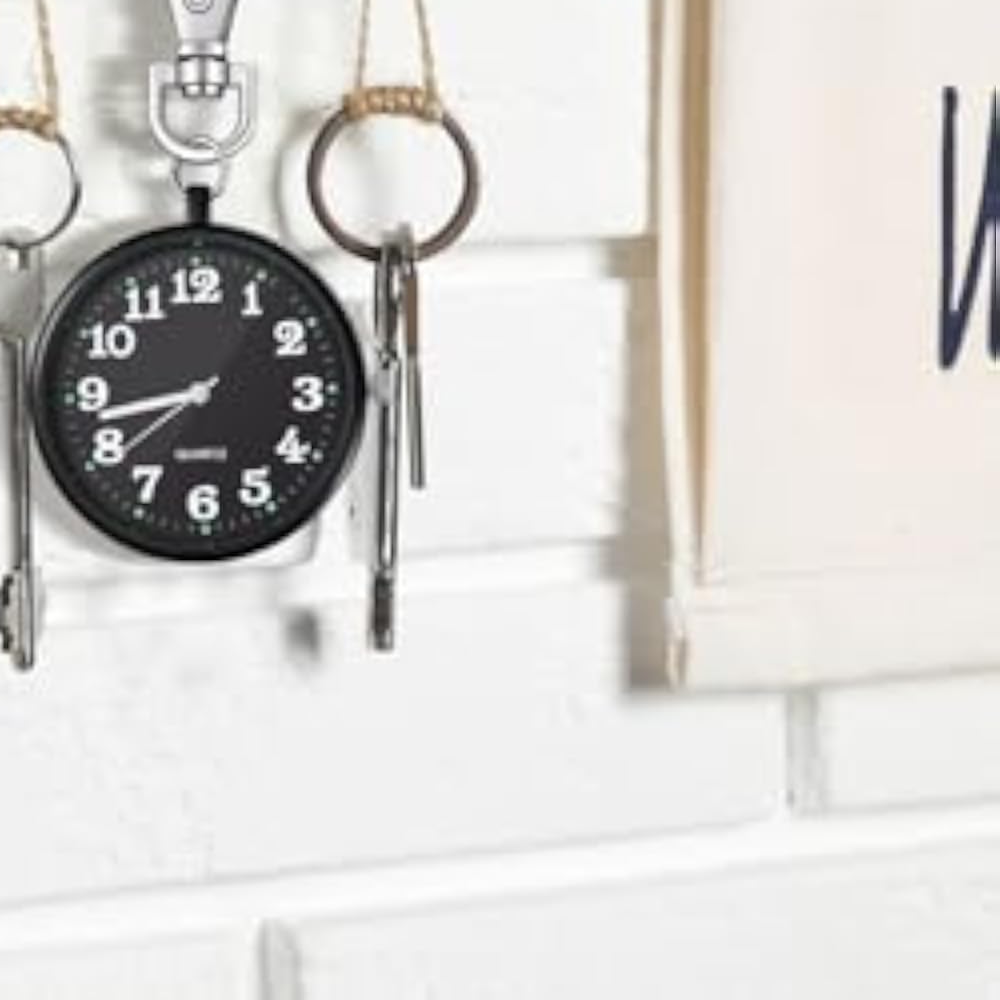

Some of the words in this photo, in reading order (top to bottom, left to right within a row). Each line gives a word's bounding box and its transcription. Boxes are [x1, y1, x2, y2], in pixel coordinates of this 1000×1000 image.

[123, 285, 167, 322] 11
[169, 267, 223, 304] 12
[241, 281, 264, 316] 1
[88, 323, 137, 359] 10
[272, 319, 309, 356] 2
[76, 376, 110, 412] 9
[291, 375, 324, 412] 3
[92, 427, 125, 464] 8
[275, 425, 312, 464] 4
[131, 464, 164, 503] 7
[237, 466, 272, 507] 5
[185, 484, 220, 521] 6
